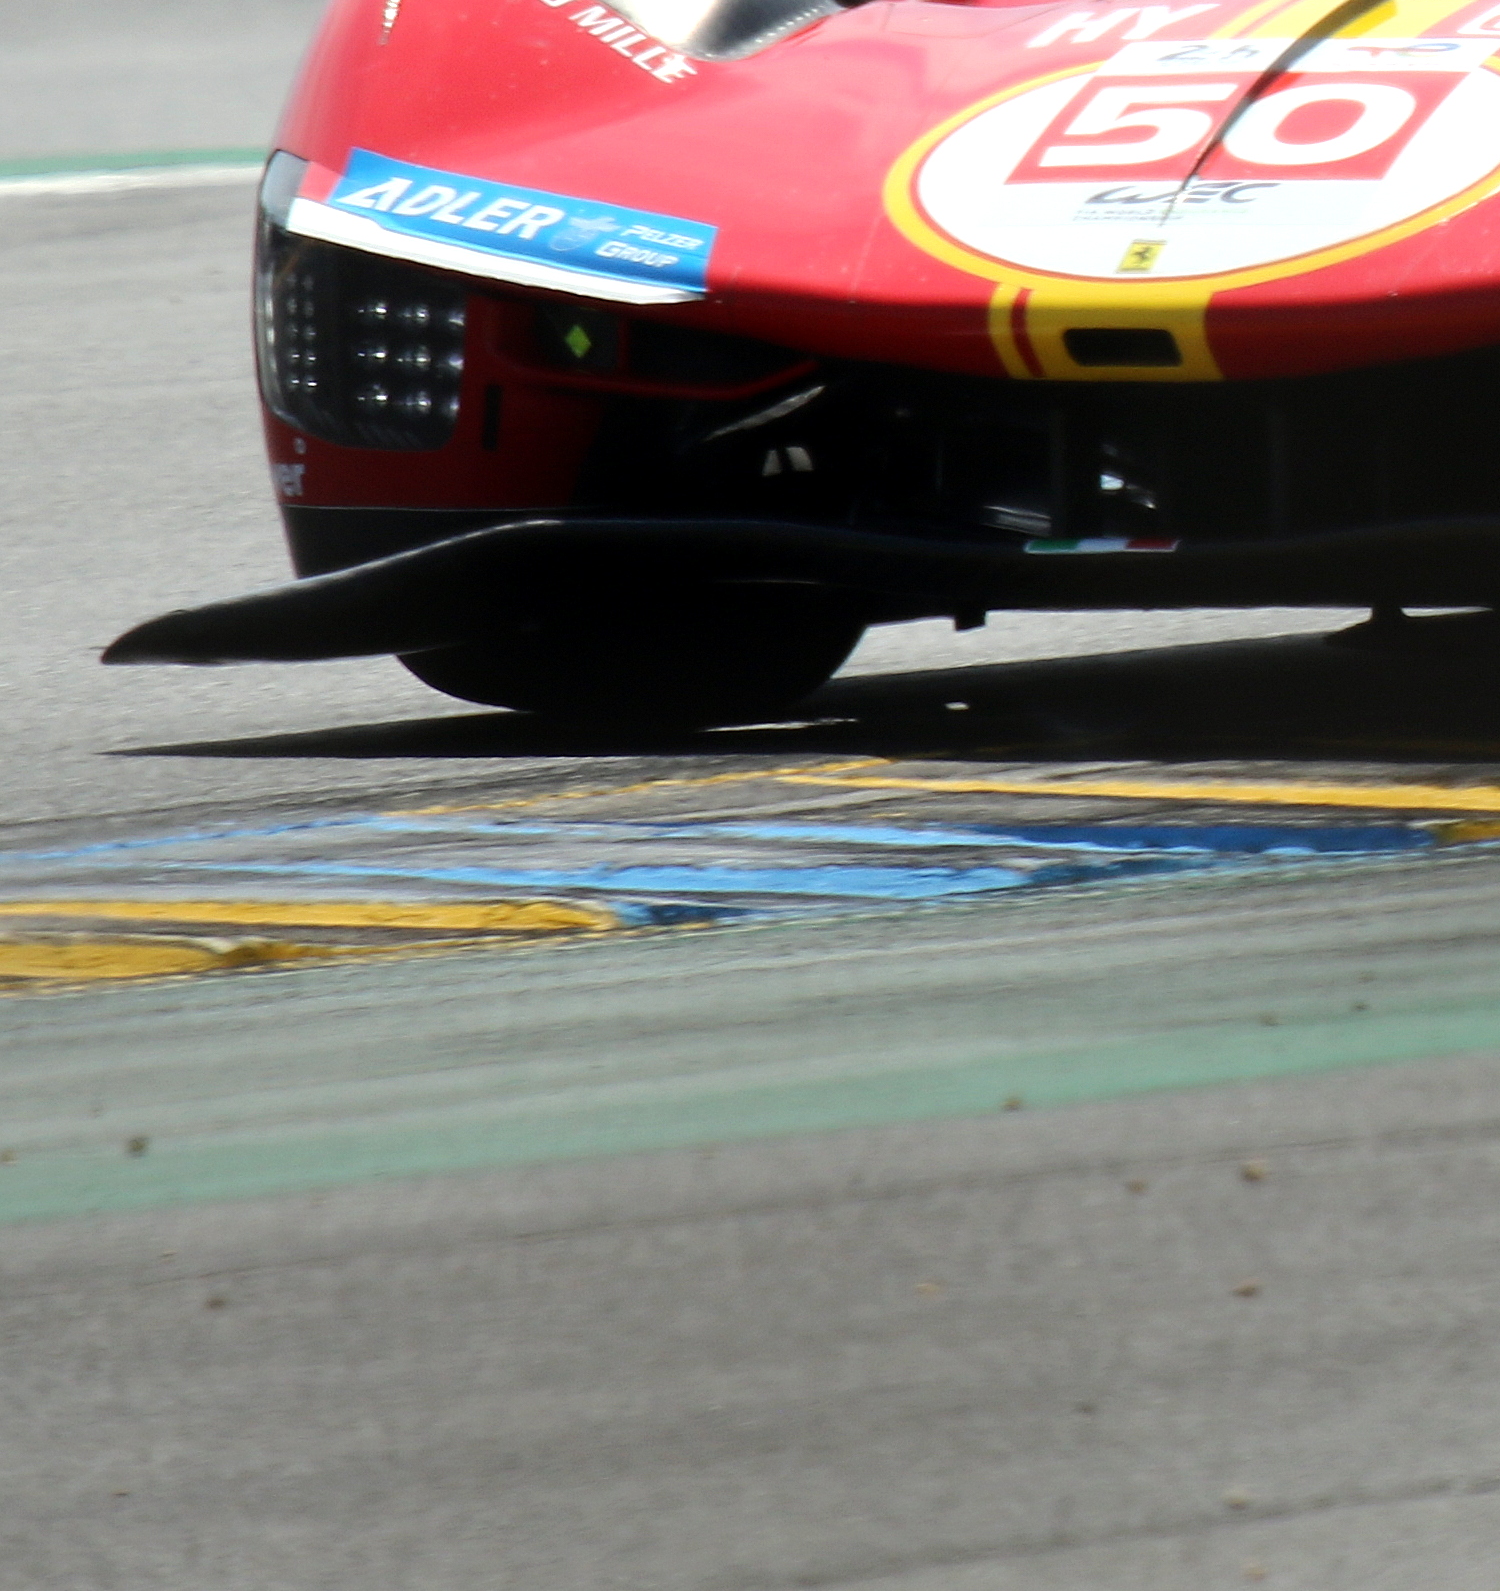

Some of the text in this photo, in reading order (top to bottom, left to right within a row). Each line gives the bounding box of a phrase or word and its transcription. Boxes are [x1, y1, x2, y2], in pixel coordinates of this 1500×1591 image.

[568, 5, 697, 85] MILLE
[1027, 3, 1221, 49] HY
[1039, 81, 1417, 169] 50
[336, 176, 565, 240] ADLER
[1084, 182, 1283, 205] WEC
[595, 240, 680, 268] GROUP
